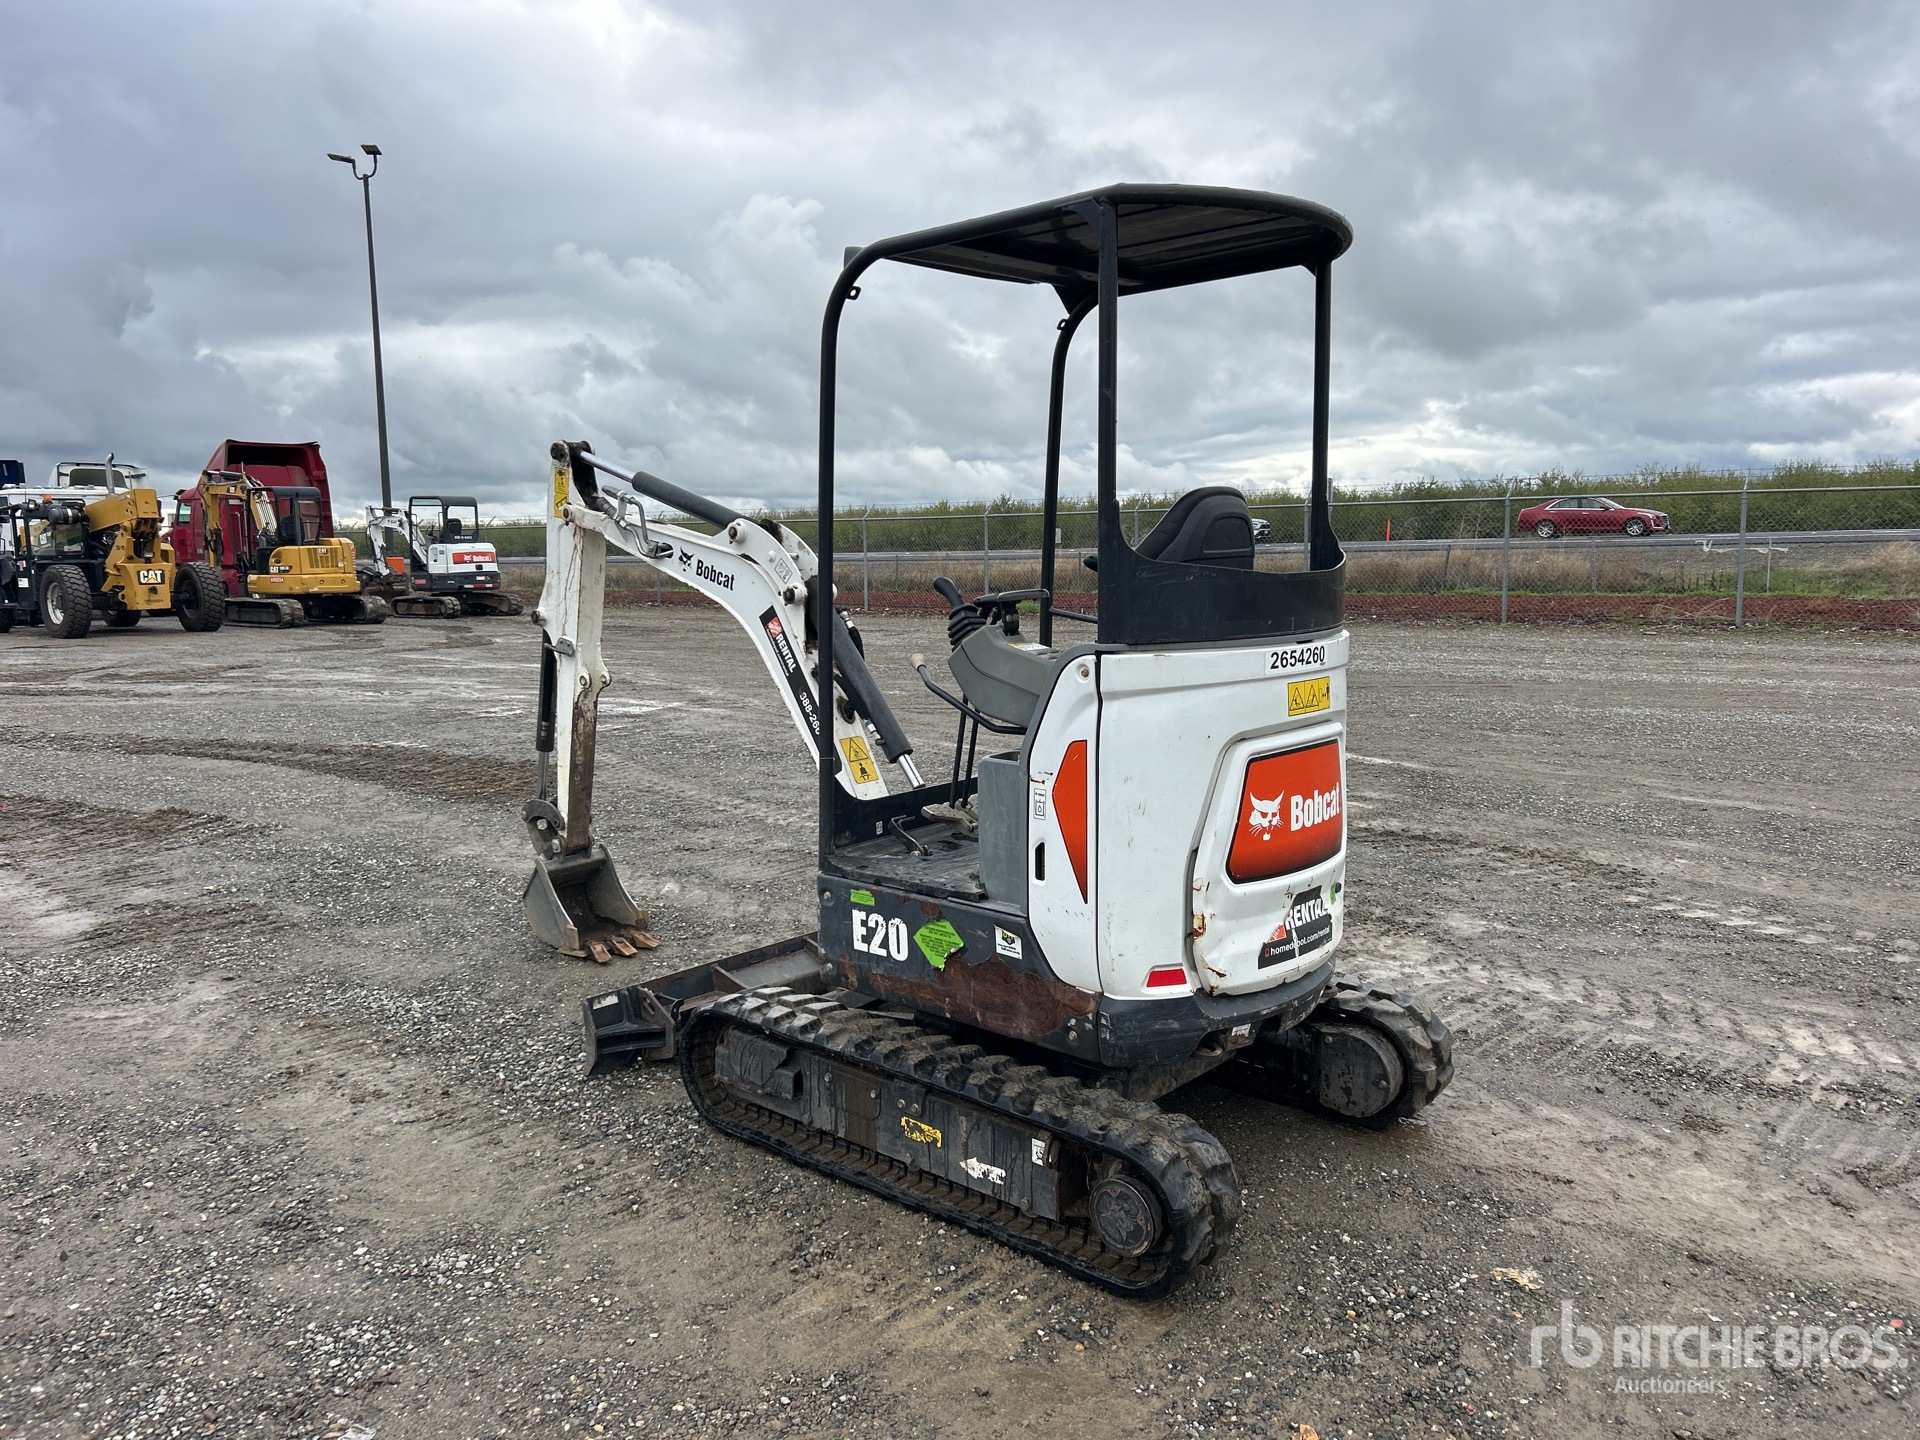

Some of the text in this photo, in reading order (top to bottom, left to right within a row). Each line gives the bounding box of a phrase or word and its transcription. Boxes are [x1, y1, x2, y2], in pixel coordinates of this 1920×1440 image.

[139, 570, 163, 584] CAT
[696, 559, 735, 591] Bobcat
[775, 633, 797, 673] RENTAL
[1270, 645, 1325, 669] 2654260
[1290, 781, 1340, 831] Bobcat
[851, 908, 909, 962] E20
